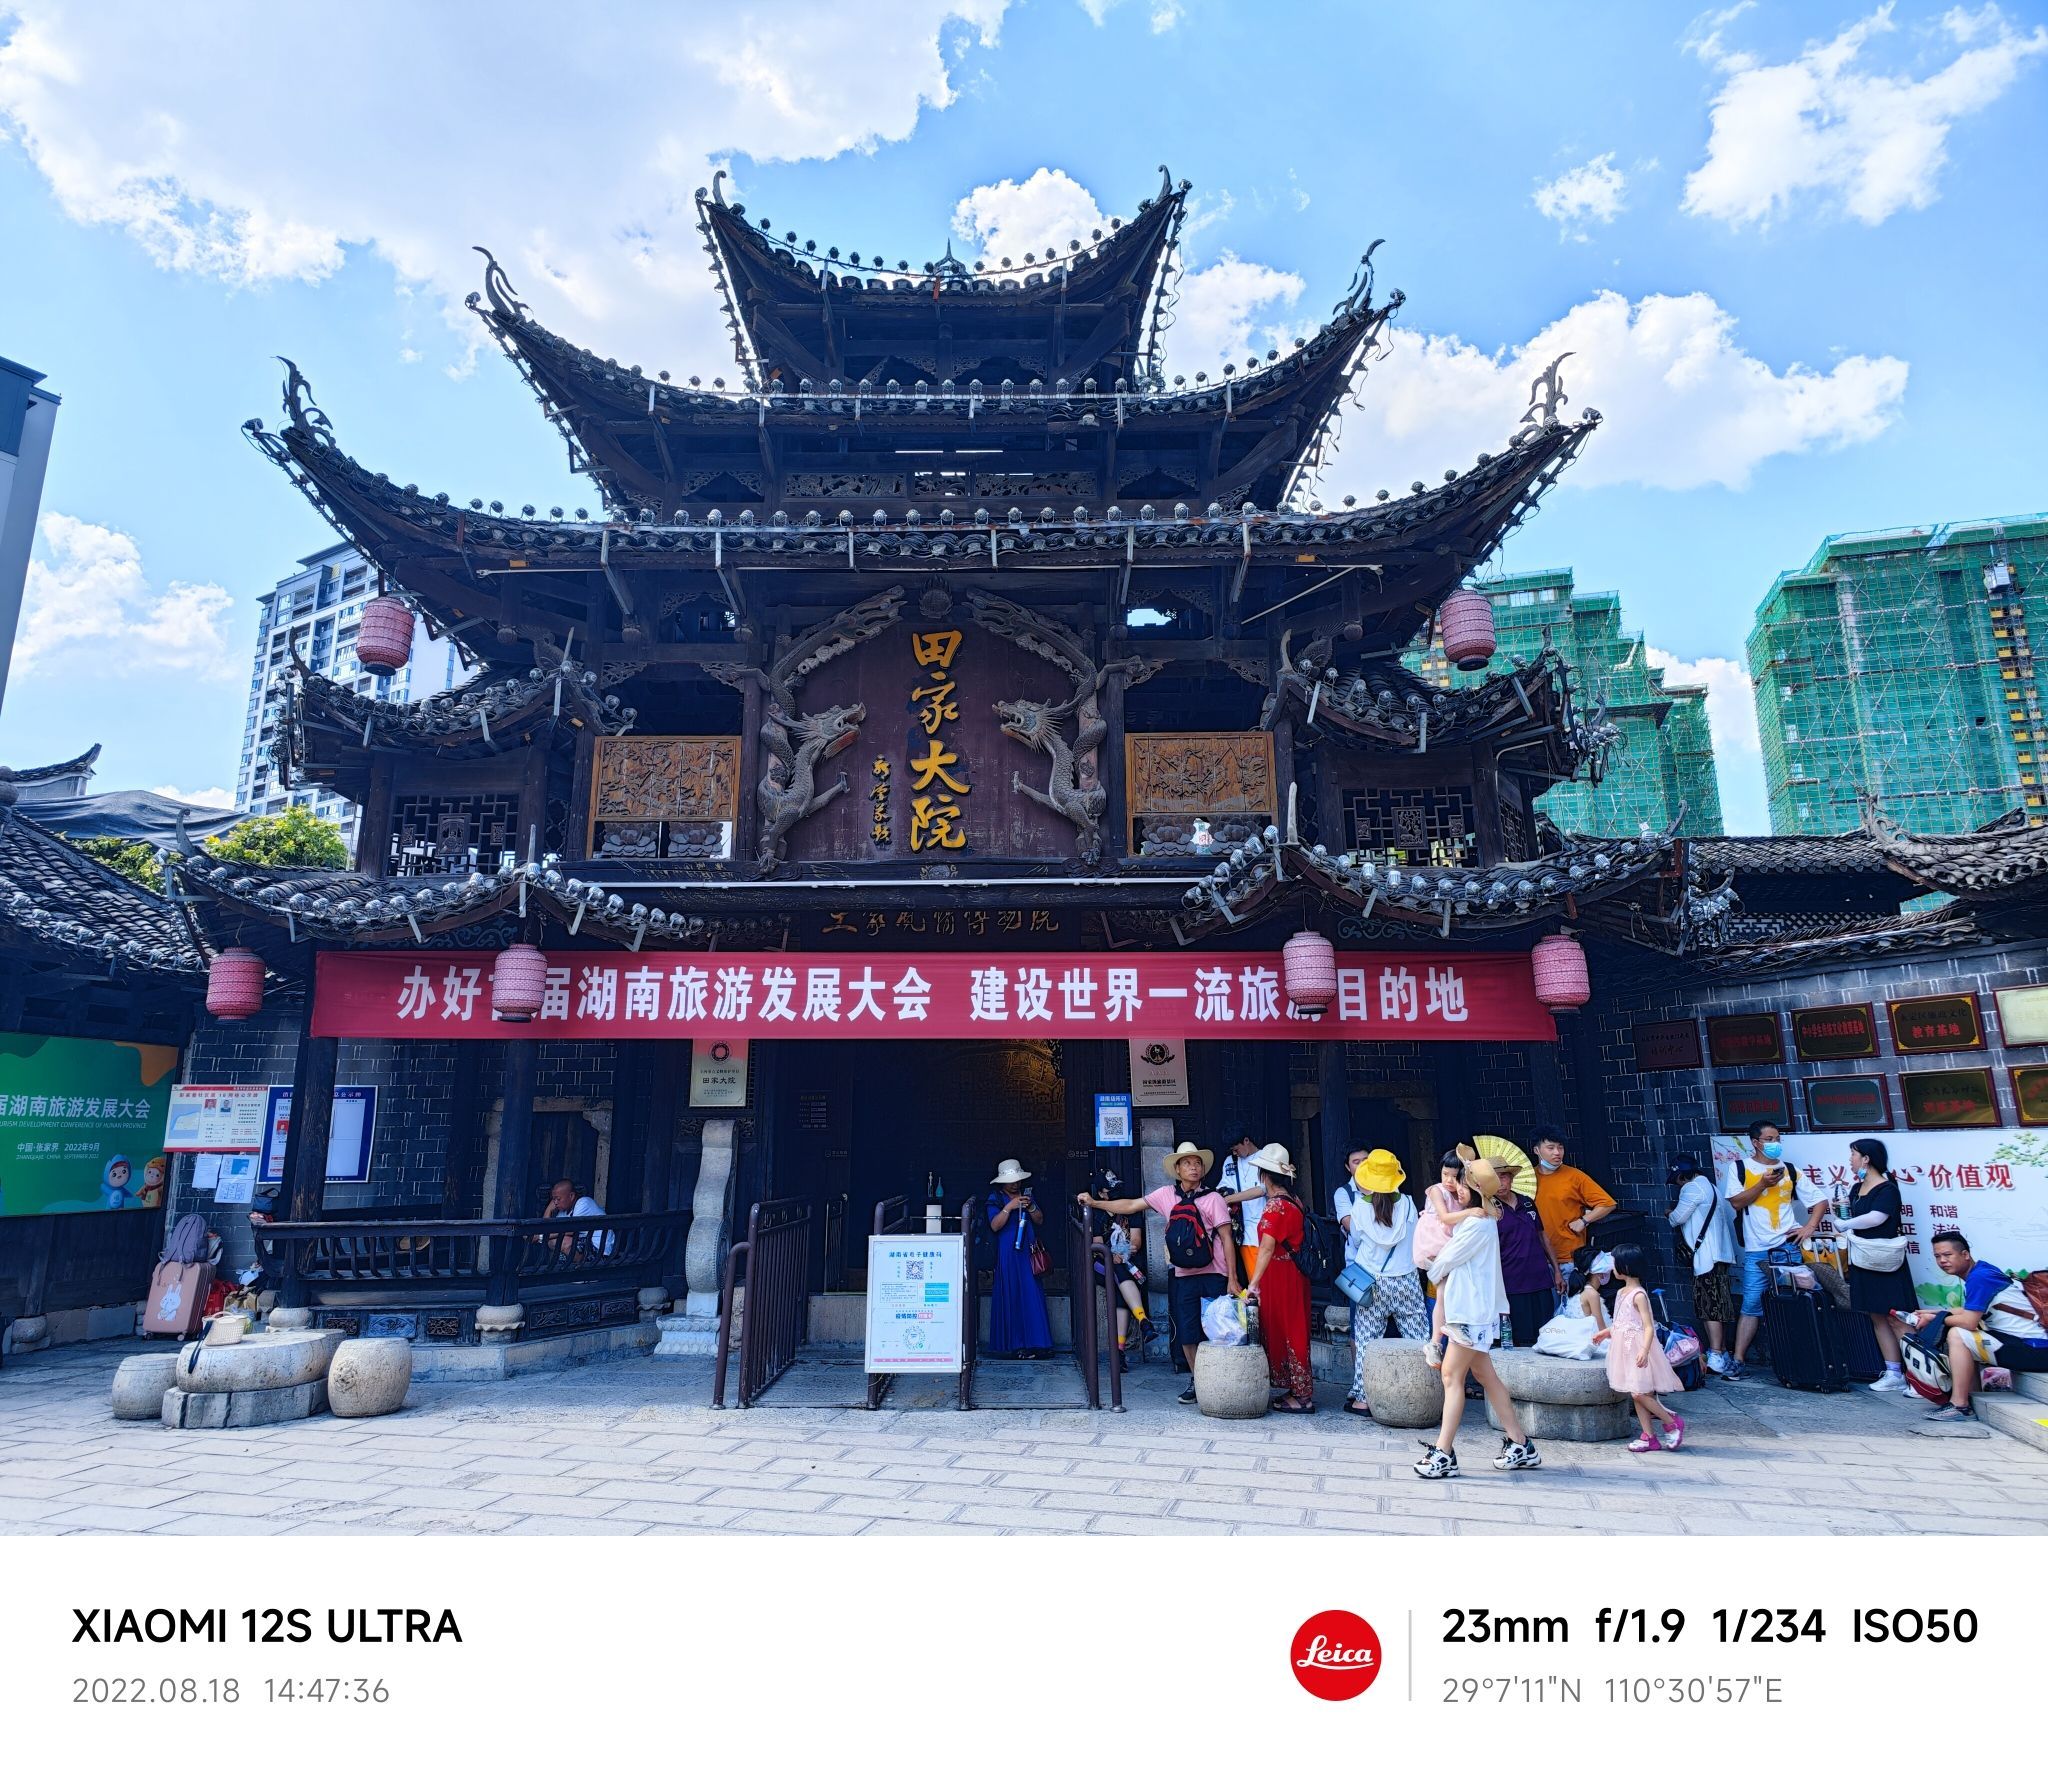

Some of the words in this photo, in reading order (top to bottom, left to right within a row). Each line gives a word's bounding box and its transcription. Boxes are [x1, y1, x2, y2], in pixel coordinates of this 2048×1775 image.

[911, 629, 971, 852] 田家大院
[396, 965, 932, 1022] 办好届湖南旅游发展大会
[970, 966, 1468, 1022] 建设世界一流旅目的地
[1911, 1024, 1961, 1038] 教育基地
[702, 1076, 736, 1085] 田家大院
[1802, 1164, 2015, 1190] 主义心价值观
[1900, 1204, 1914, 1217] 明
[1929, 1204, 1958, 1219] 和谐
[1899, 1223, 1917, 1236] 正
[1905, 1240, 1921, 1255] 信
